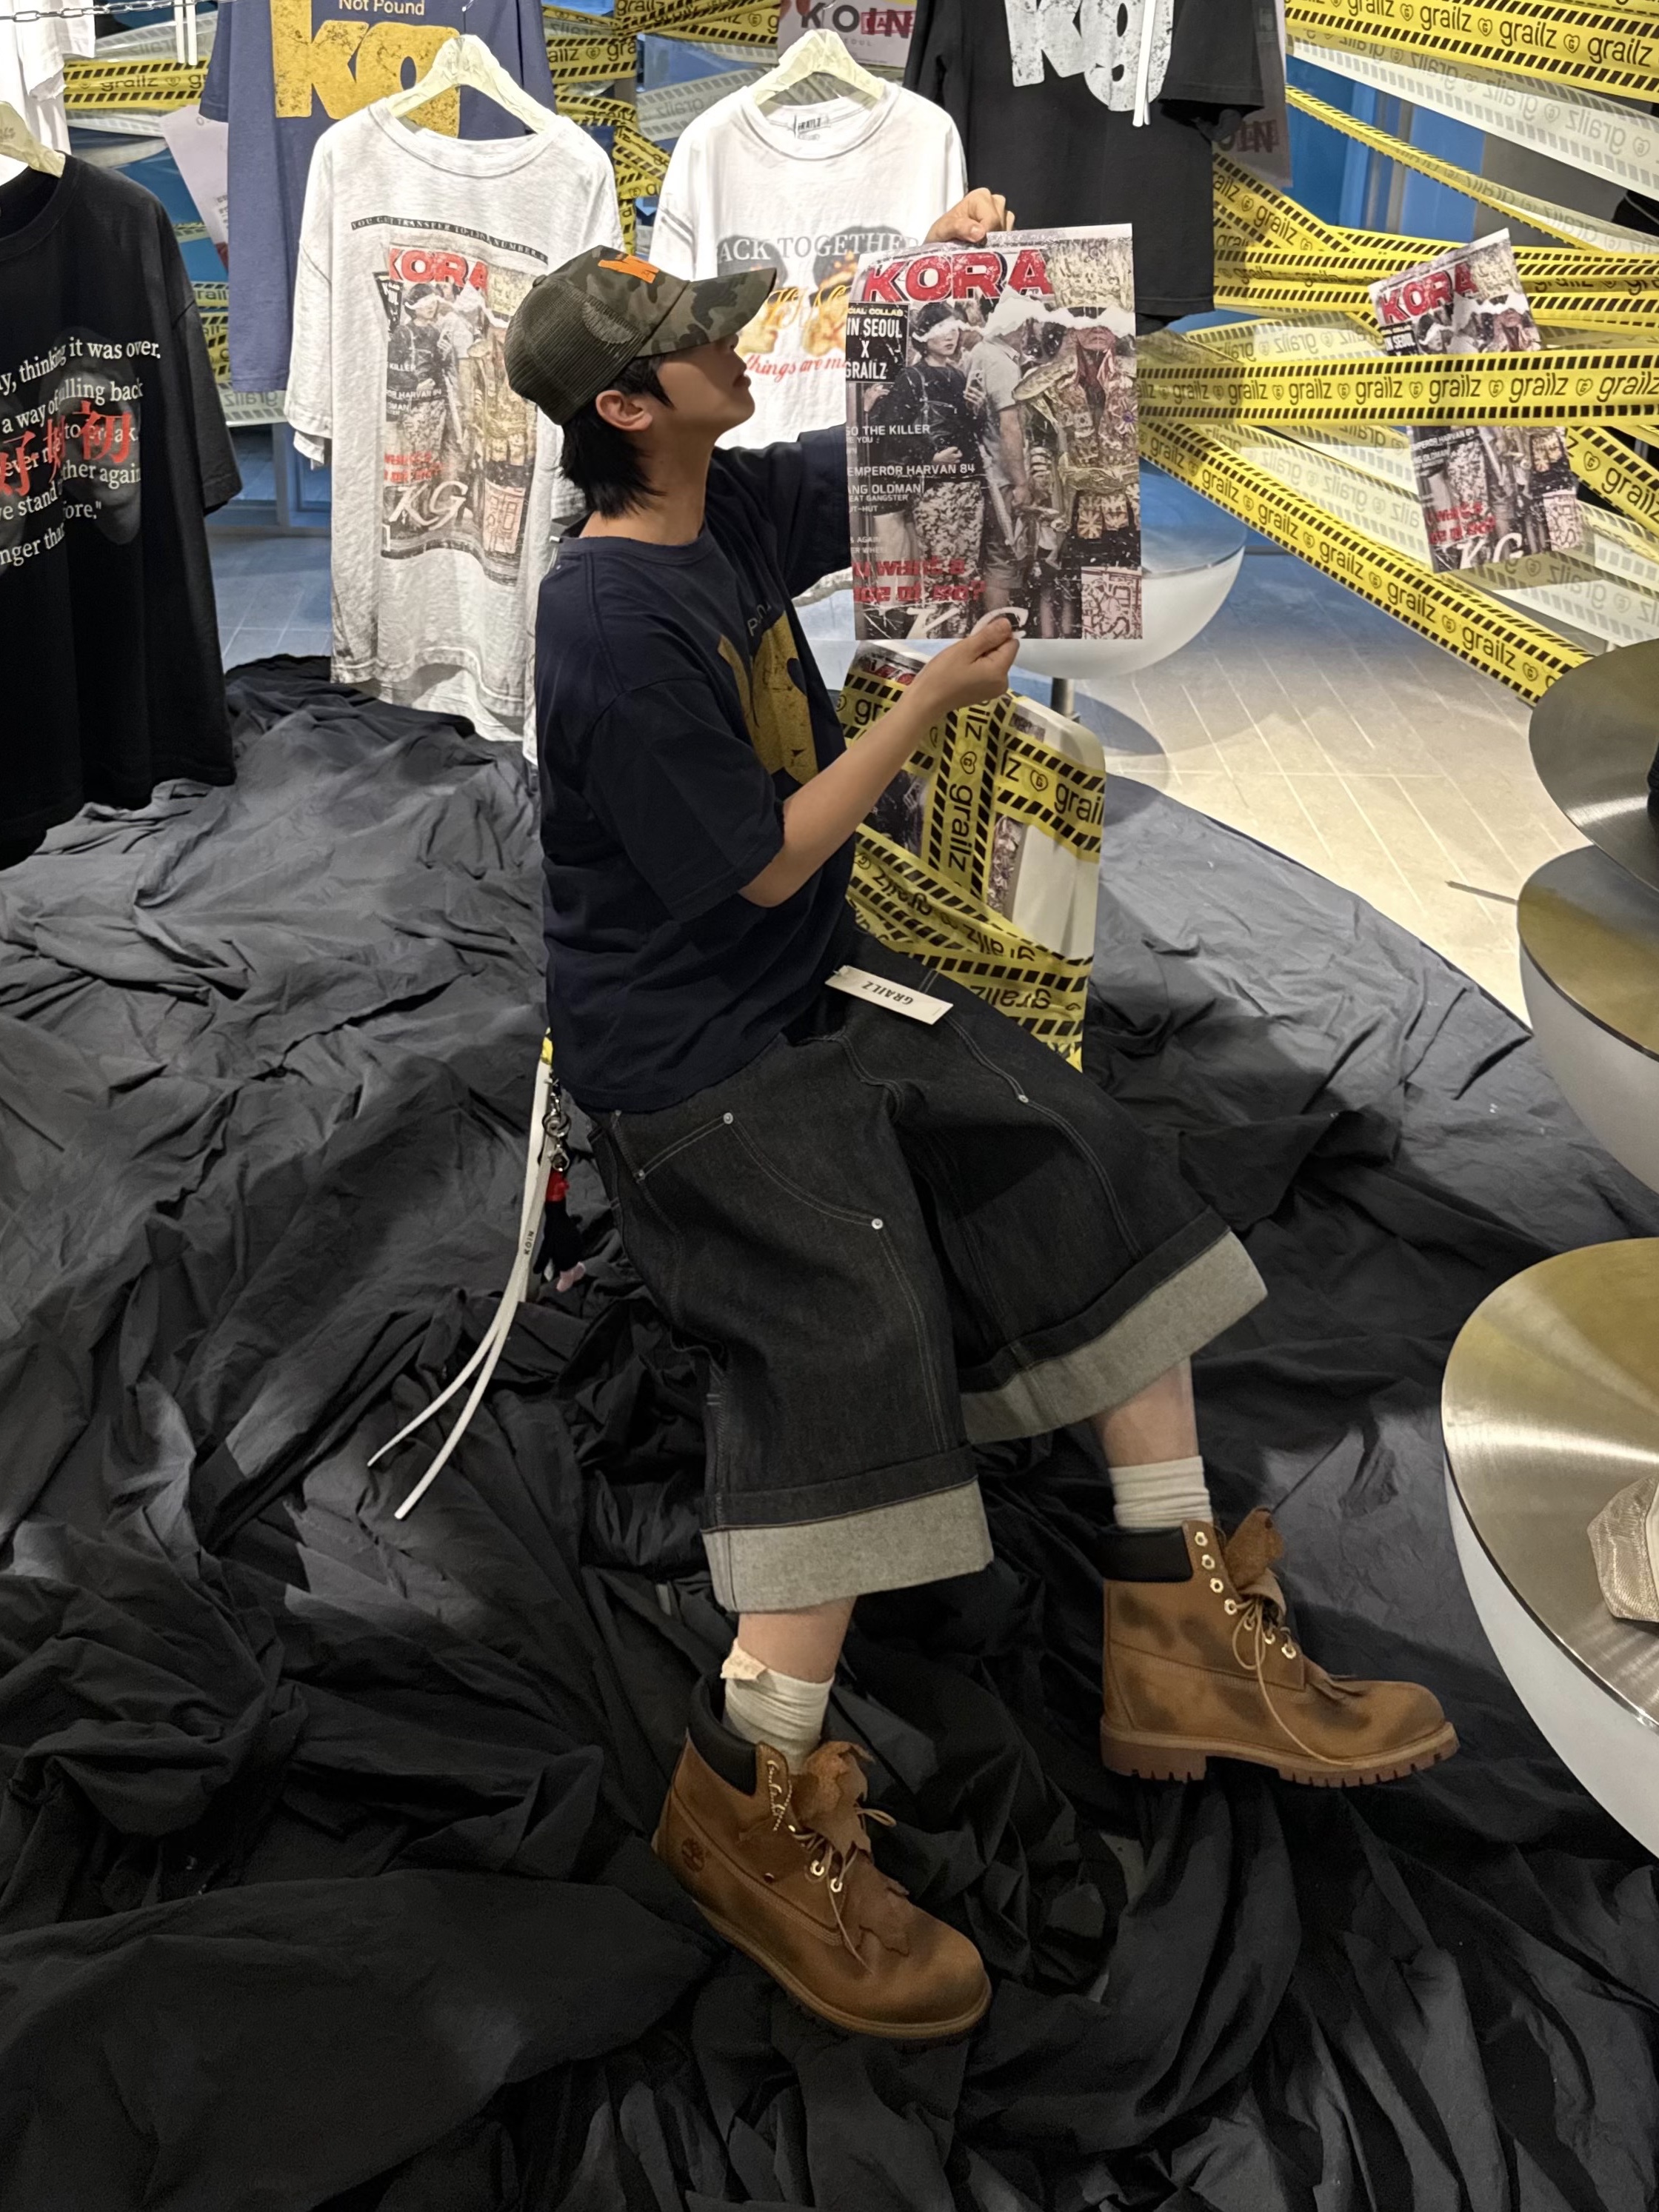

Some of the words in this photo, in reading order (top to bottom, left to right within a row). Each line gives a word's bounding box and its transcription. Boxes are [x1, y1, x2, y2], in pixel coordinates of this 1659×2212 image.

[338, 0, 368, 11] Not
[1420, 5, 1472, 31] grailz
[1499, 21, 1558, 50] grailz
[1588, 36, 1654, 67] grailz
[548, 47, 579, 62] ailz
[607, 41, 637, 61] gra
[1212, 170, 1241, 203] railz
[1254, 205, 1298, 246] grailz
[493, 238, 538, 258] NUMBER
[719, 238, 772, 263] ACK
[389, 248, 490, 292] KORA
[862, 249, 1055, 304] KORA
[1380, 261, 1480, 324] KORA
[848, 307, 867, 315] CIAL
[869, 307, 904, 317] COLLAB
[847, 318, 861, 337] IN
[864, 318, 903, 338] SEOUL
[70, 336, 83, 358] it
[87, 341, 122, 360] was
[126, 340, 161, 359] over.
[861, 341, 869, 359] X
[845, 361, 887, 381] GRAILZ
[1136, 381, 1156, 399] ailz
[1172, 379, 1210, 405] grailz
[1228, 379, 1269, 406] grailz
[1289, 378, 1332, 405] grailz
[1355, 376, 1403, 404] grailz
[1429, 375, 1481, 404] grailz
[1509, 372, 1569, 404] grailz
[1596, 371, 1659, 402] grailz
[2, 418, 14, 434] a
[16, 404, 47, 428] way
[110, 377, 144, 402] back
[863, 425, 886, 435] THE
[889, 424, 931, 435] KILLER
[61, 459, 96, 481] ther
[847, 465, 903, 477] EMPEROR
[907, 464, 957, 475] HARVAN
[960, 463, 975, 474] 84
[18, 481, 59, 516] stand
[866, 494, 909, 502] GANGSTER
[871, 483, 921, 495] OLDMAN
[1150, 436, 1186, 470] grailz
[1202, 467, 1239, 504] grailz
[1258, 501, 1299, 541] grailz
[1319, 540, 1364, 580] grailz
[1387, 581, 1438, 624] grailz
[1462, 625, 1516, 672] grailz
[965, 706, 991, 741] ilz
[1054, 783, 1104, 826] grail
[948, 783, 974, 872] grailz
[862, 980, 914, 1006] GRAILZ
